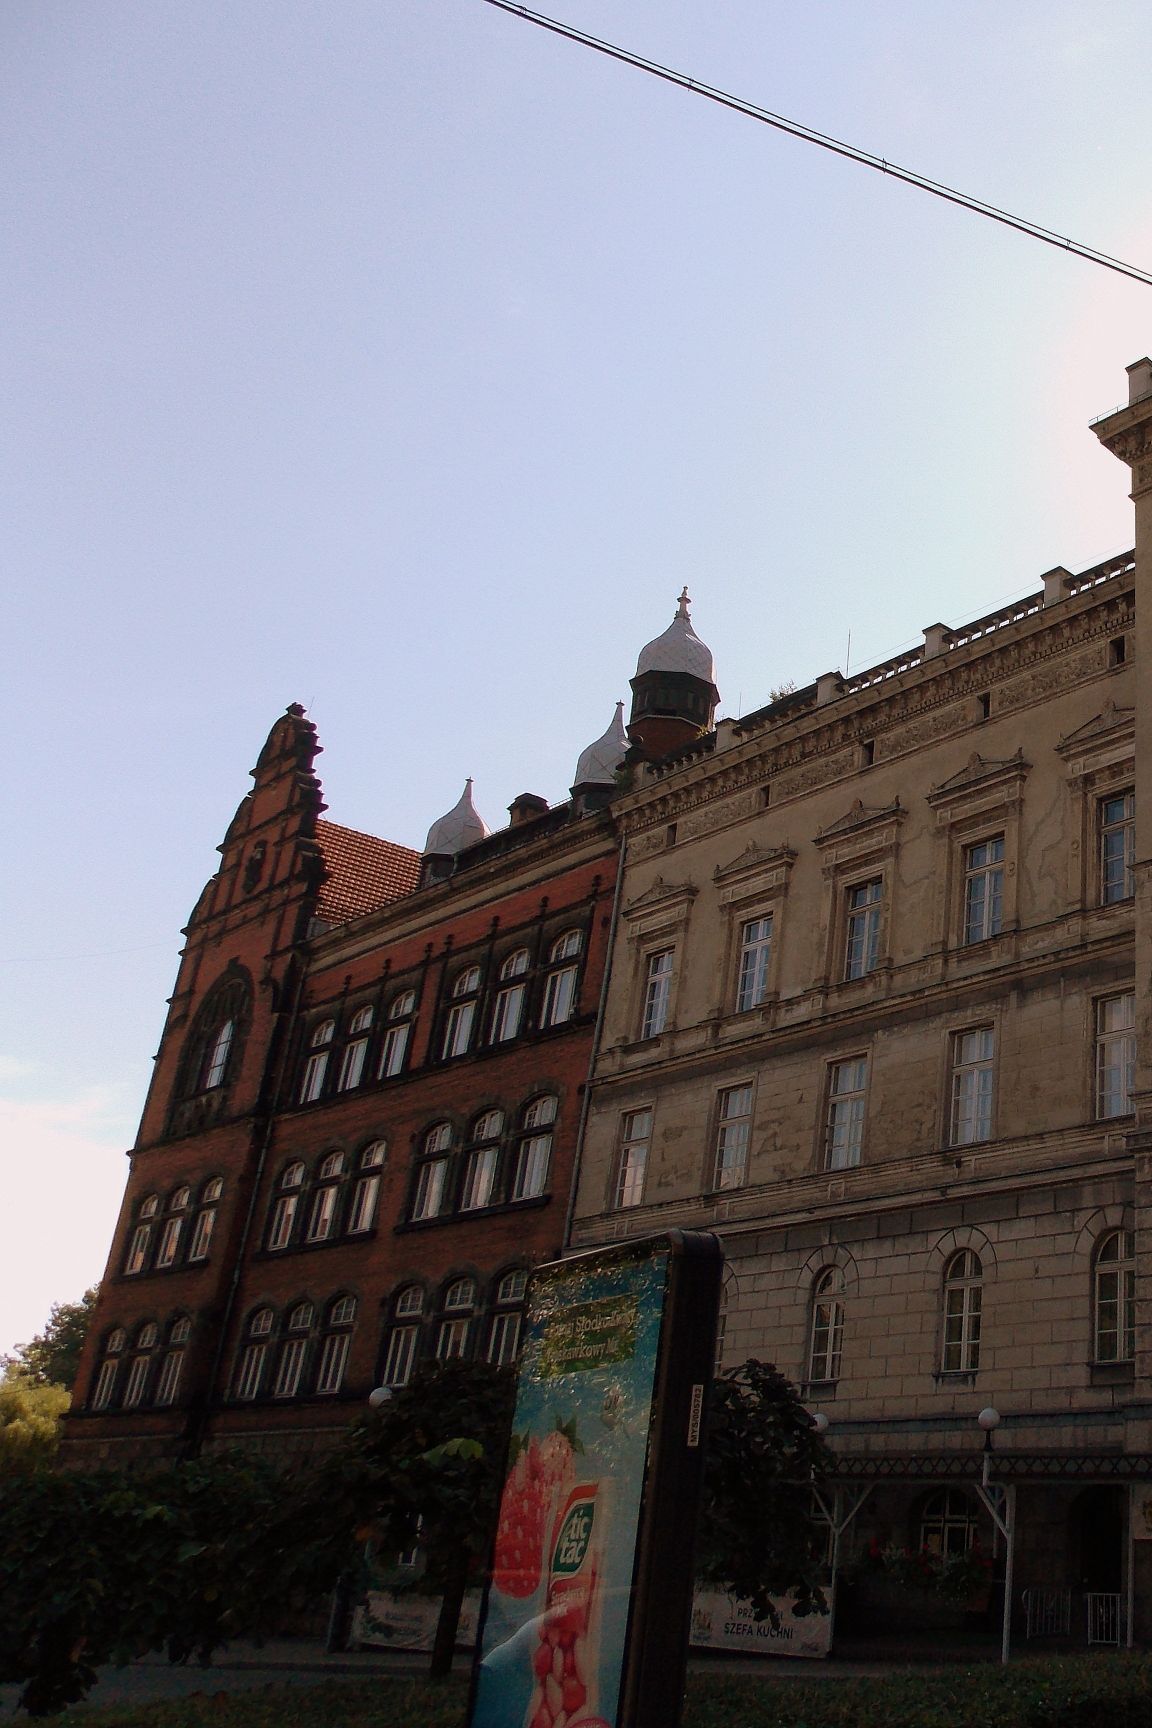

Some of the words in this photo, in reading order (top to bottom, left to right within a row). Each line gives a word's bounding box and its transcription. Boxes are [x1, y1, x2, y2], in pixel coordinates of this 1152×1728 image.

[565, 1509, 591, 1540] tic
[560, 1537, 585, 1564] tac
[724, 1622, 753, 1636] SZEFA
[756, 1624, 794, 1640] KUCHNI
